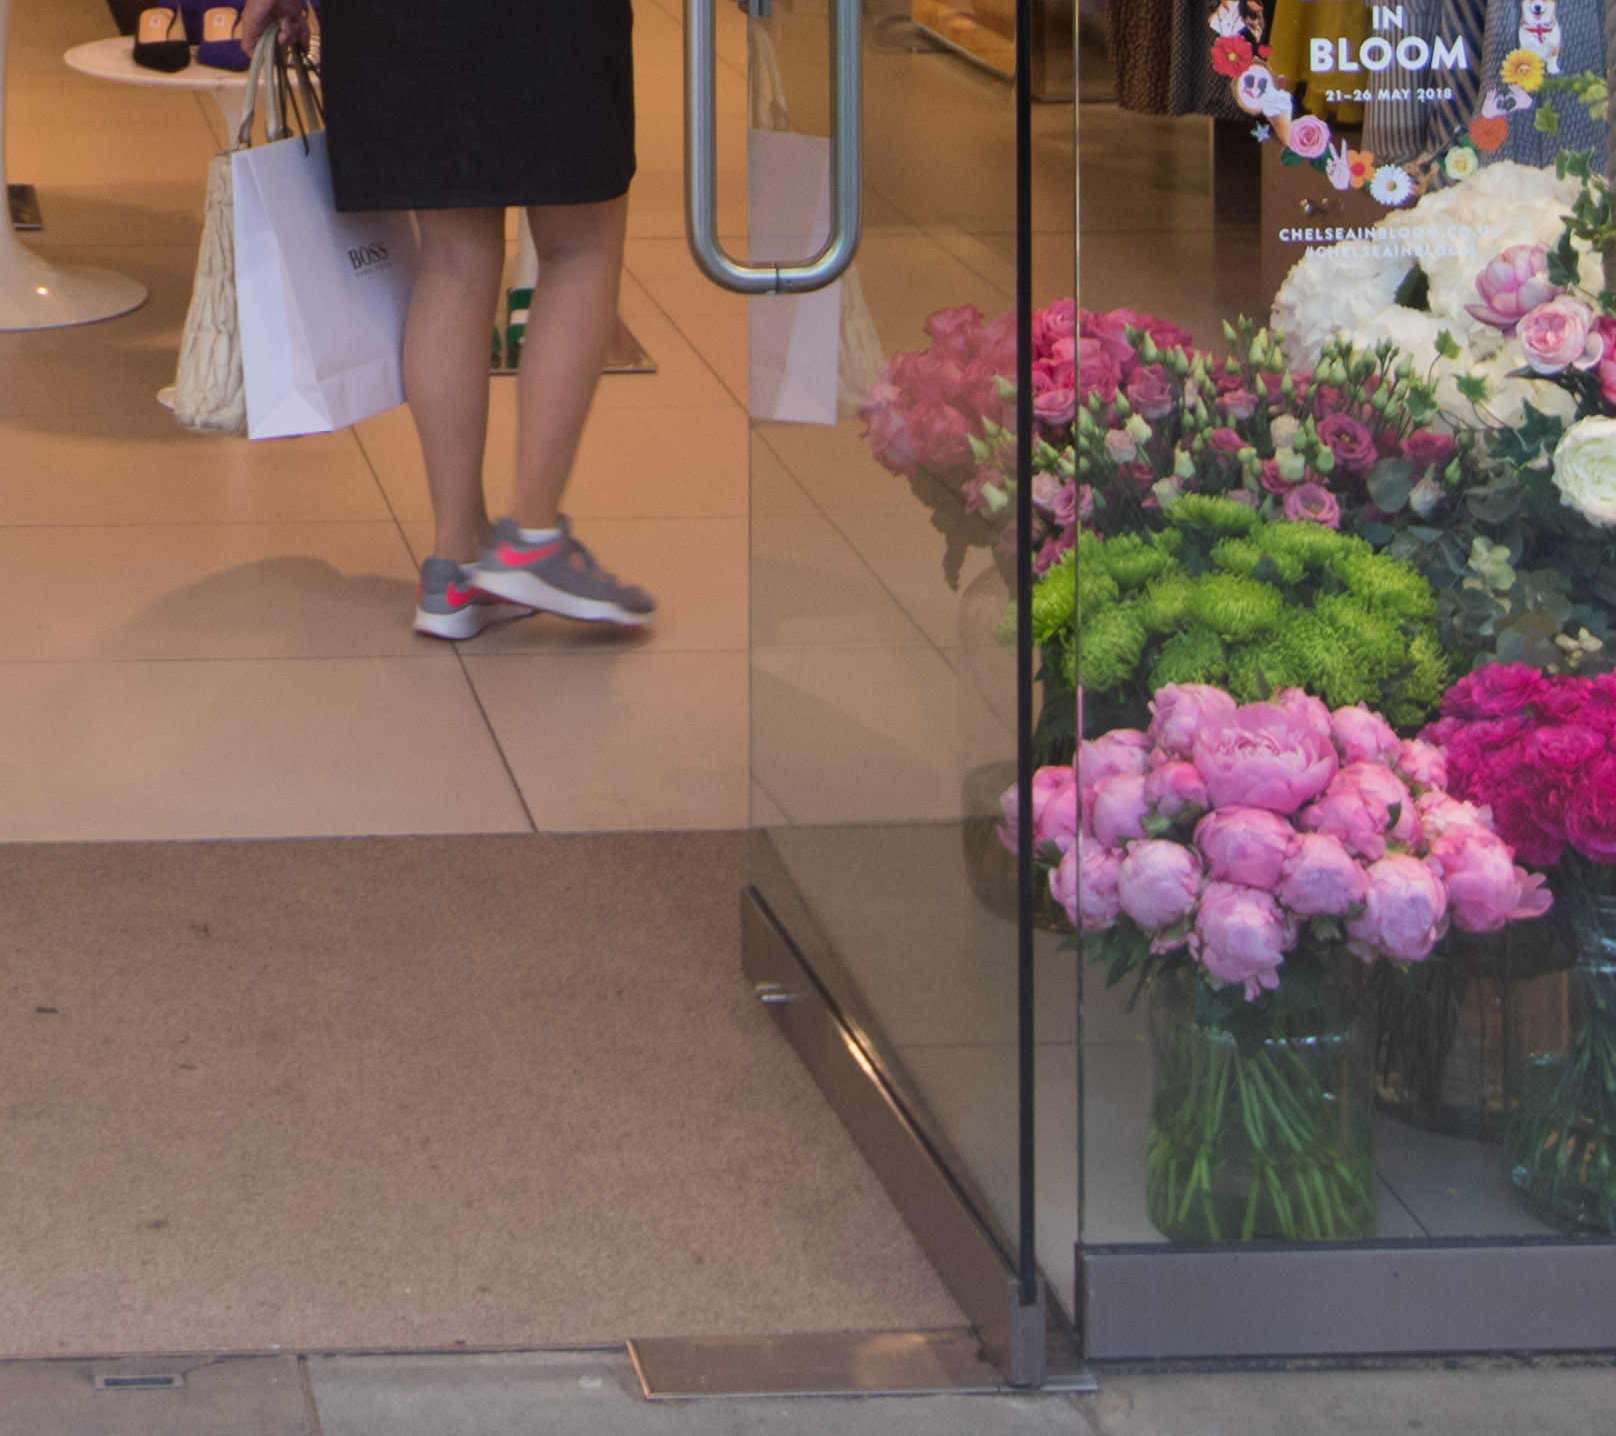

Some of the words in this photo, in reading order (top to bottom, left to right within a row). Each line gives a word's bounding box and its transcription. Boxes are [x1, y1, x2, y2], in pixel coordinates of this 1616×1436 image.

[1372, 5, 1405, 31] IN
[1309, 35, 1468, 73] BLOOM
[1377, 88, 1411, 101] MAY
[1416, 87, 1453, 102] 2018
[347, 240, 389, 270] BOSS
